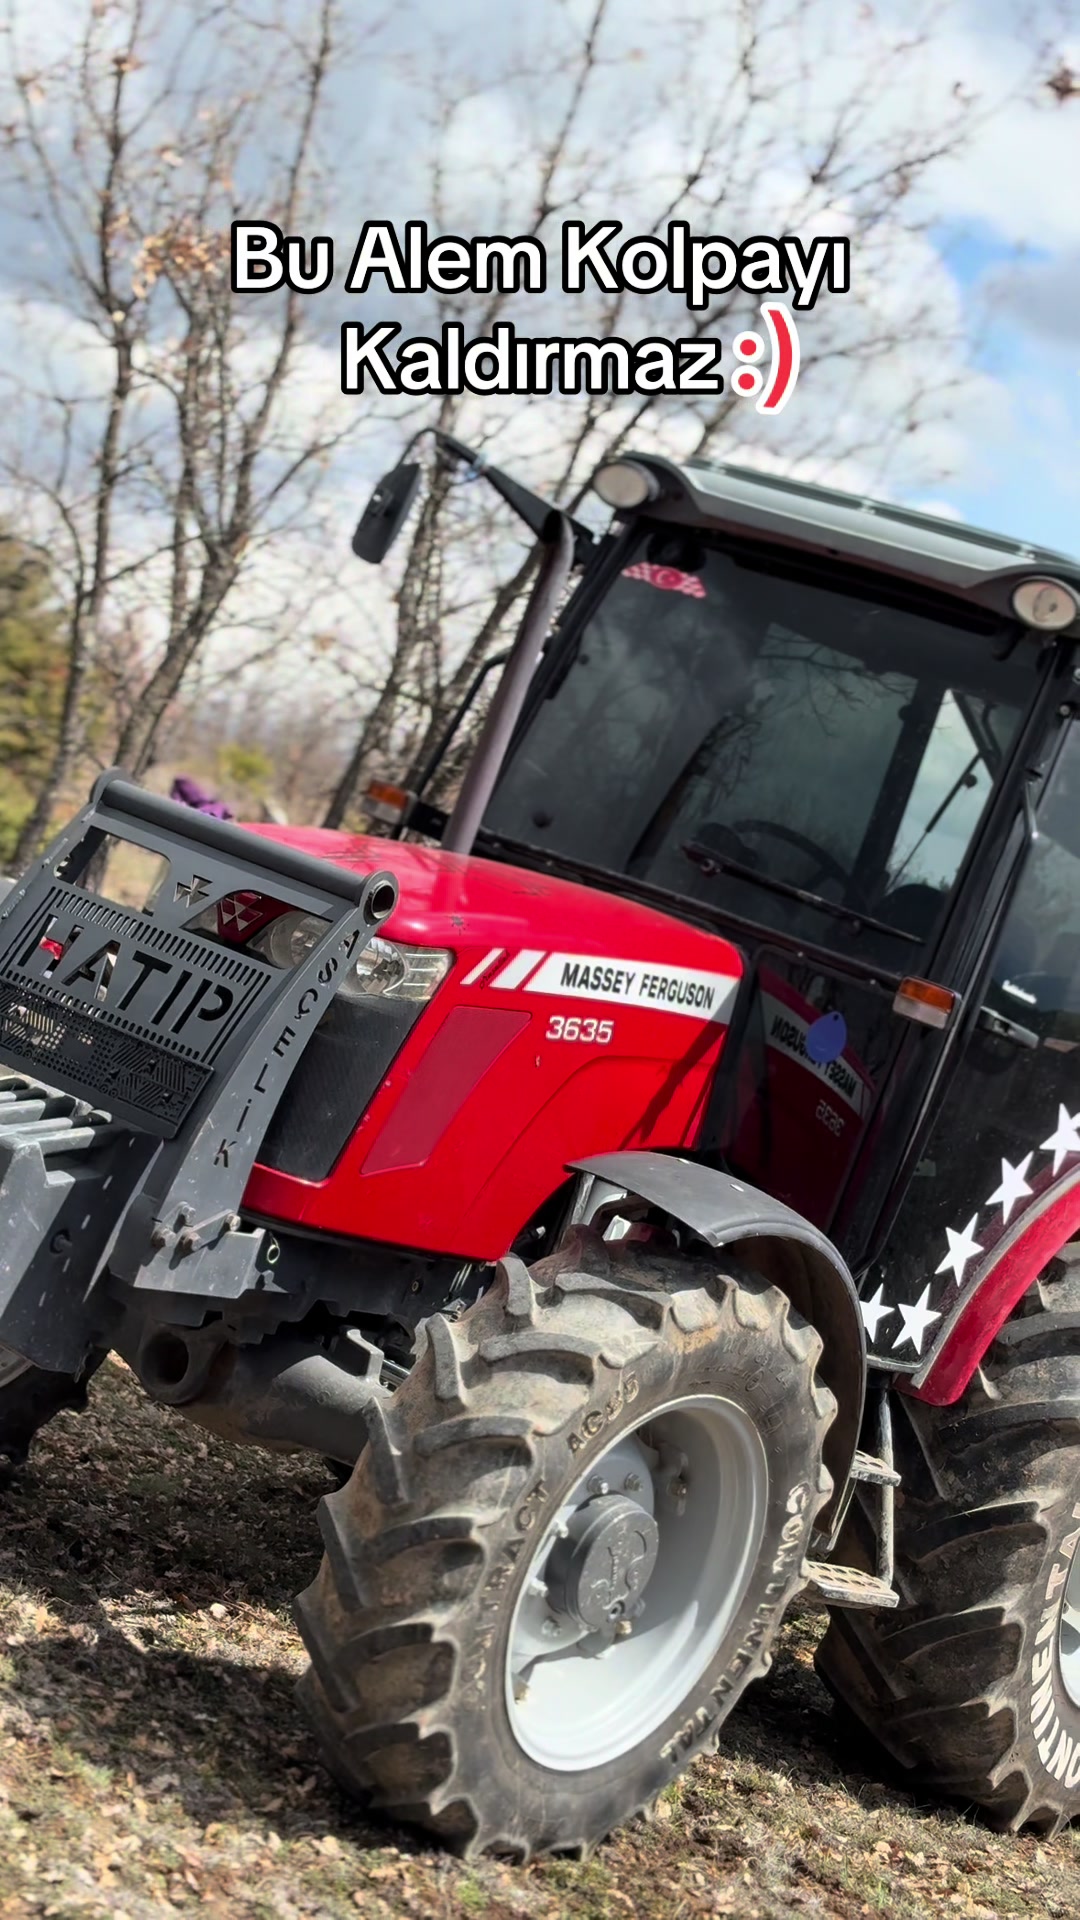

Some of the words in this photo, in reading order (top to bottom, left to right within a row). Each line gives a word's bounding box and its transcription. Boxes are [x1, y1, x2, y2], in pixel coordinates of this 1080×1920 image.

[16, 912, 235, 1035] HATIP
[560, 961, 636, 995] MASSEY
[639, 973, 715, 1010] FERGUSON
[545, 1014, 615, 1045] 3635
